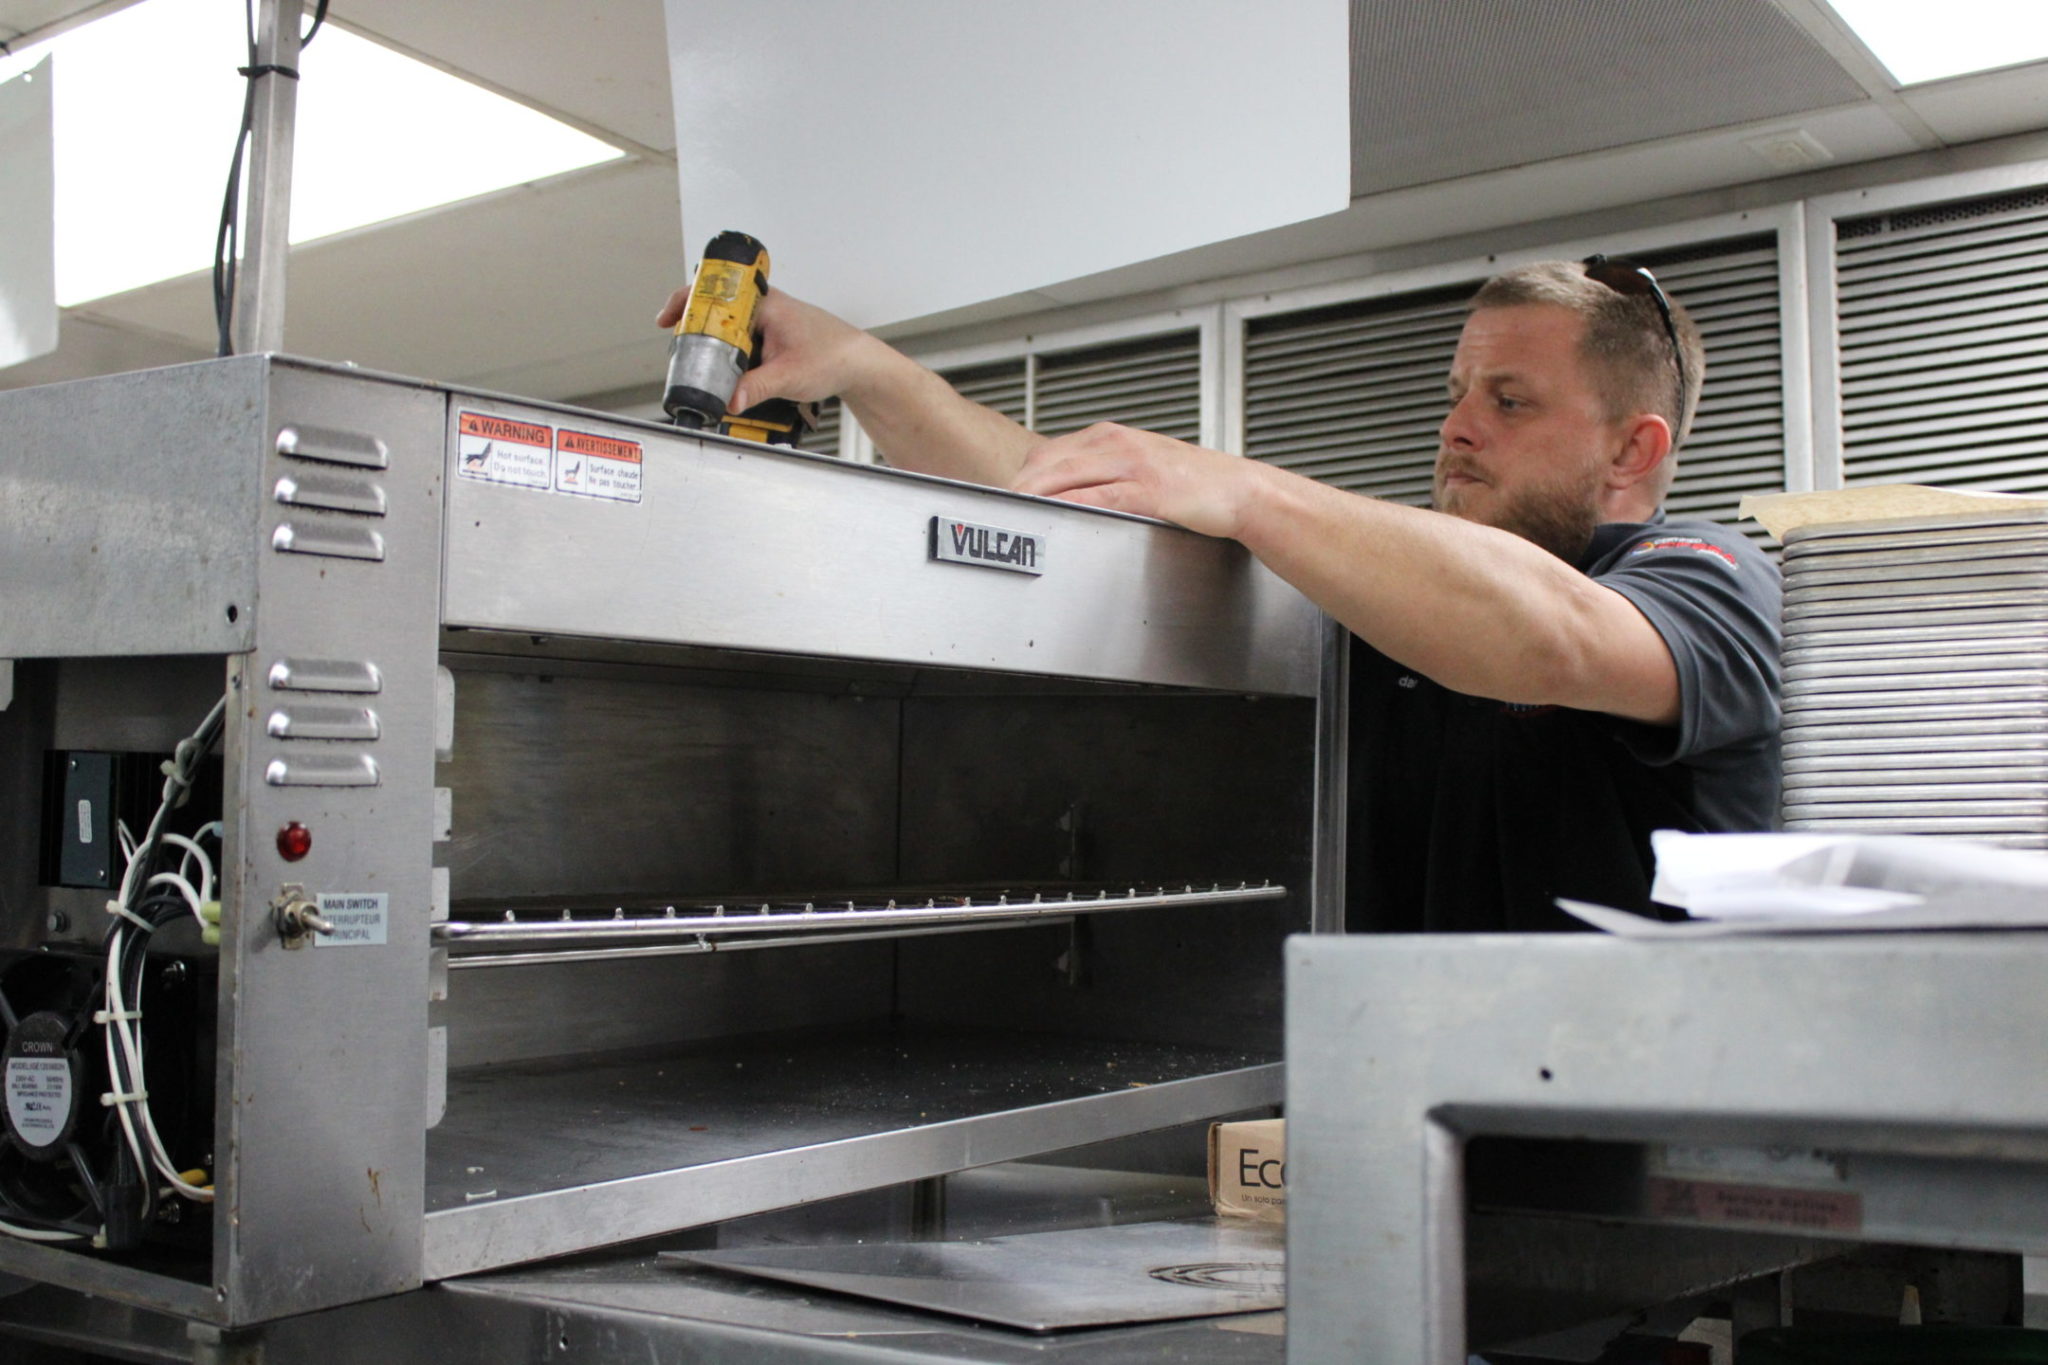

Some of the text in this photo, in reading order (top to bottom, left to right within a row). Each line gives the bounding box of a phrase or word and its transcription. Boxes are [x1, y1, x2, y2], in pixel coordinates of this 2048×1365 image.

[481, 419, 545, 443] WARNING
[497, 449, 512, 459] Hot
[576, 436, 640, 460] AVERTISSEMENT
[494, 461, 506, 472] Do
[507, 464, 521, 474] not
[590, 463, 639, 480] Surface chaude
[588, 475, 597, 484] Ne
[599, 478, 610, 487] pas
[950, 523, 1036, 567] VULCAN
[324, 898, 378, 910] MAIN SWITCH
[22, 1041, 54, 1053] CROWN
[1241, 1194, 1252, 1202] Un
[1254, 1195, 1270, 1204] solo
